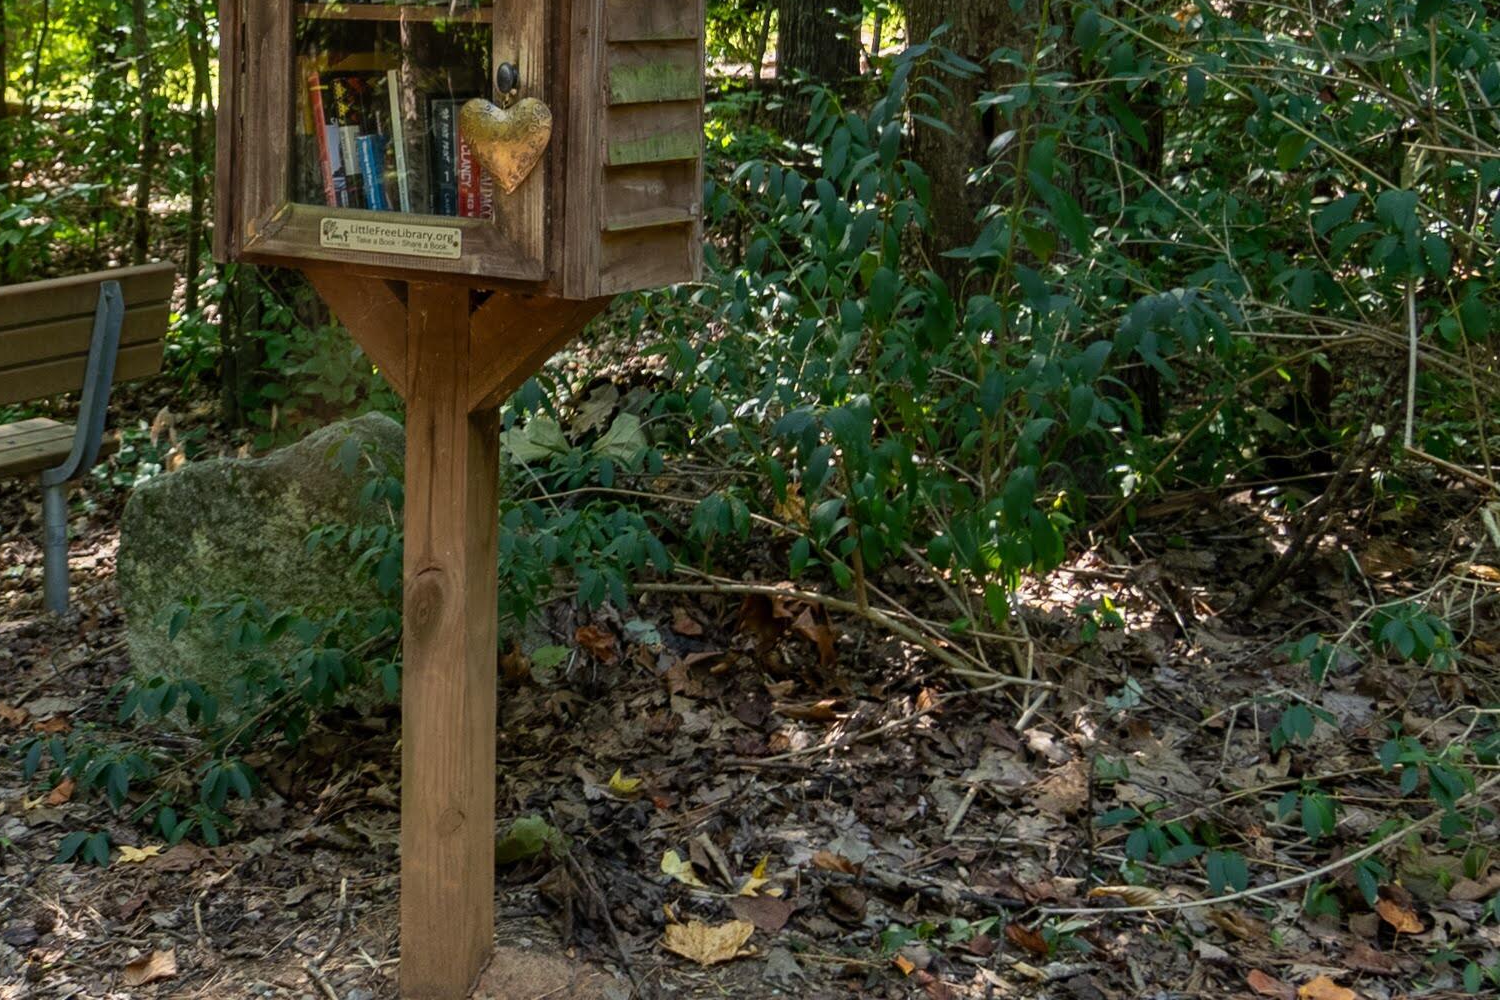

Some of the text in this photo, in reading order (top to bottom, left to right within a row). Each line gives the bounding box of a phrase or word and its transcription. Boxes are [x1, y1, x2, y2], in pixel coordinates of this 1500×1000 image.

[460, 144, 472, 188] CLANCY
[350, 224, 454, 243] LittleFreeLibrary.org
[401, 239, 422, 248] Share
[429, 241, 447, 249] Book
